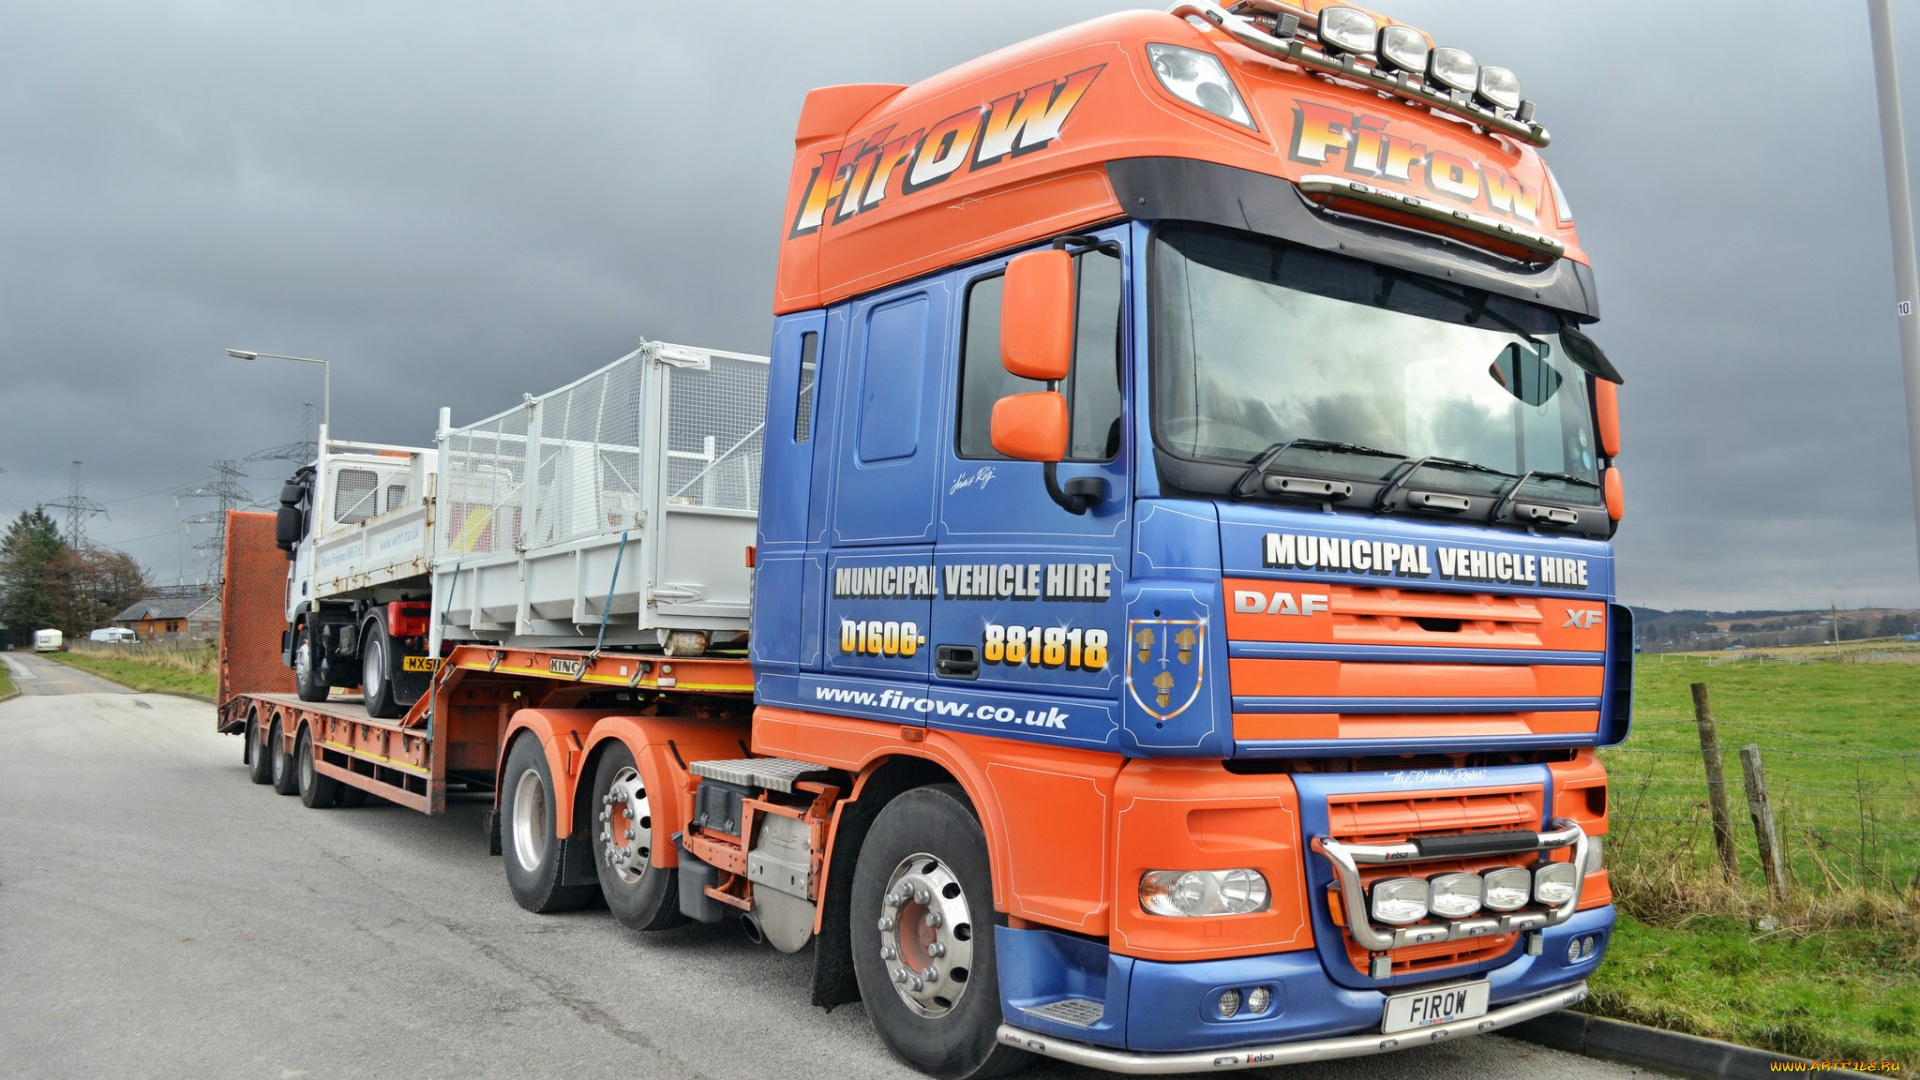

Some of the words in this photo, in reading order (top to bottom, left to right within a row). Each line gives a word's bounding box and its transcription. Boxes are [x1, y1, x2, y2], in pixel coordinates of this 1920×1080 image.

[1898, 302, 1910, 314] 10
[1261, 533, 1431, 575] MUNICIPAL
[1434, 547, 1537, 586] VEHICLE
[1539, 556, 1589, 590] HIRE
[834, 565, 938, 600] MUNICIPAL
[942, 563, 1040, 601] VEHICLE
[1042, 563, 1111, 602] HIRE
[1234, 591, 1328, 616] DAF
[1563, 609, 1603, 630] XF
[982, 624, 1109, 672] 881818
[816, 686, 1070, 730] www.firow.co.uk
[1385, 851, 1409, 860] Kelsa
[1246, 1053, 1274, 1064] Kelsa
